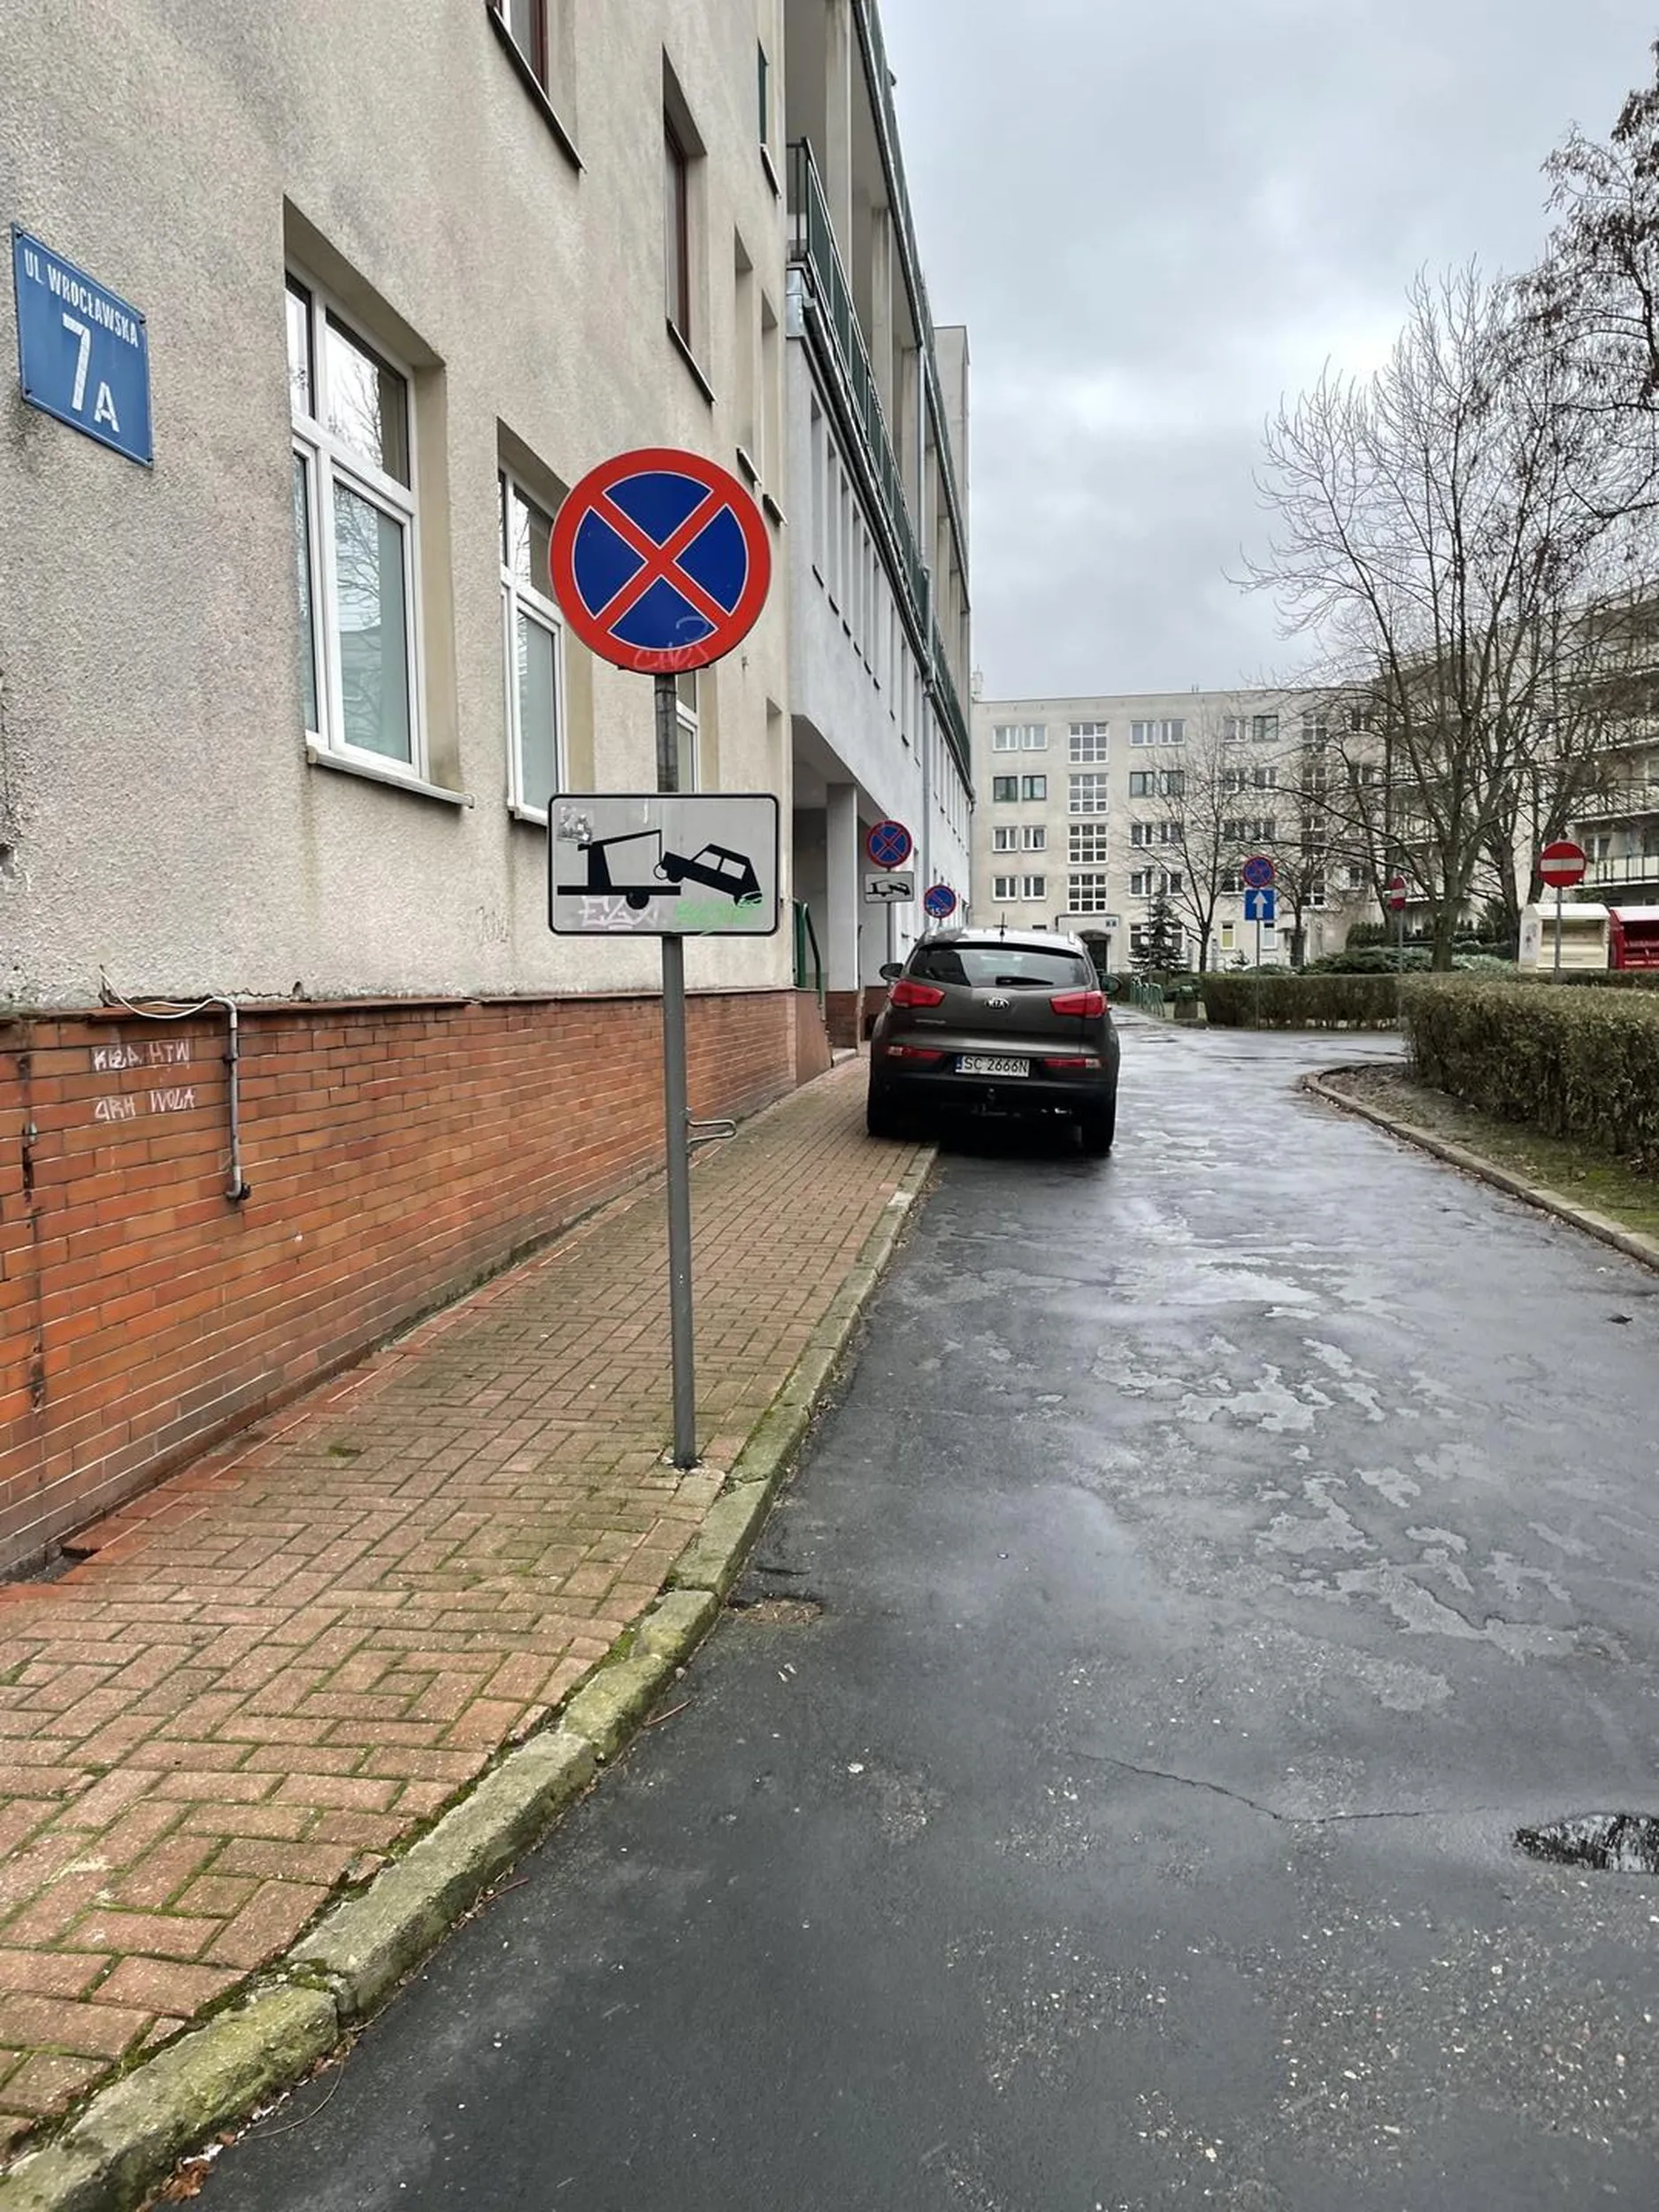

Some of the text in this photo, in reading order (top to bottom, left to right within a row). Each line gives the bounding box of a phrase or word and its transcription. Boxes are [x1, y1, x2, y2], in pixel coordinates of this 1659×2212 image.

[47, 263, 139, 348] WROCŁAWSKA
[987, 998, 1008, 1009] KIA
[964, 1056, 983, 1070] SC
